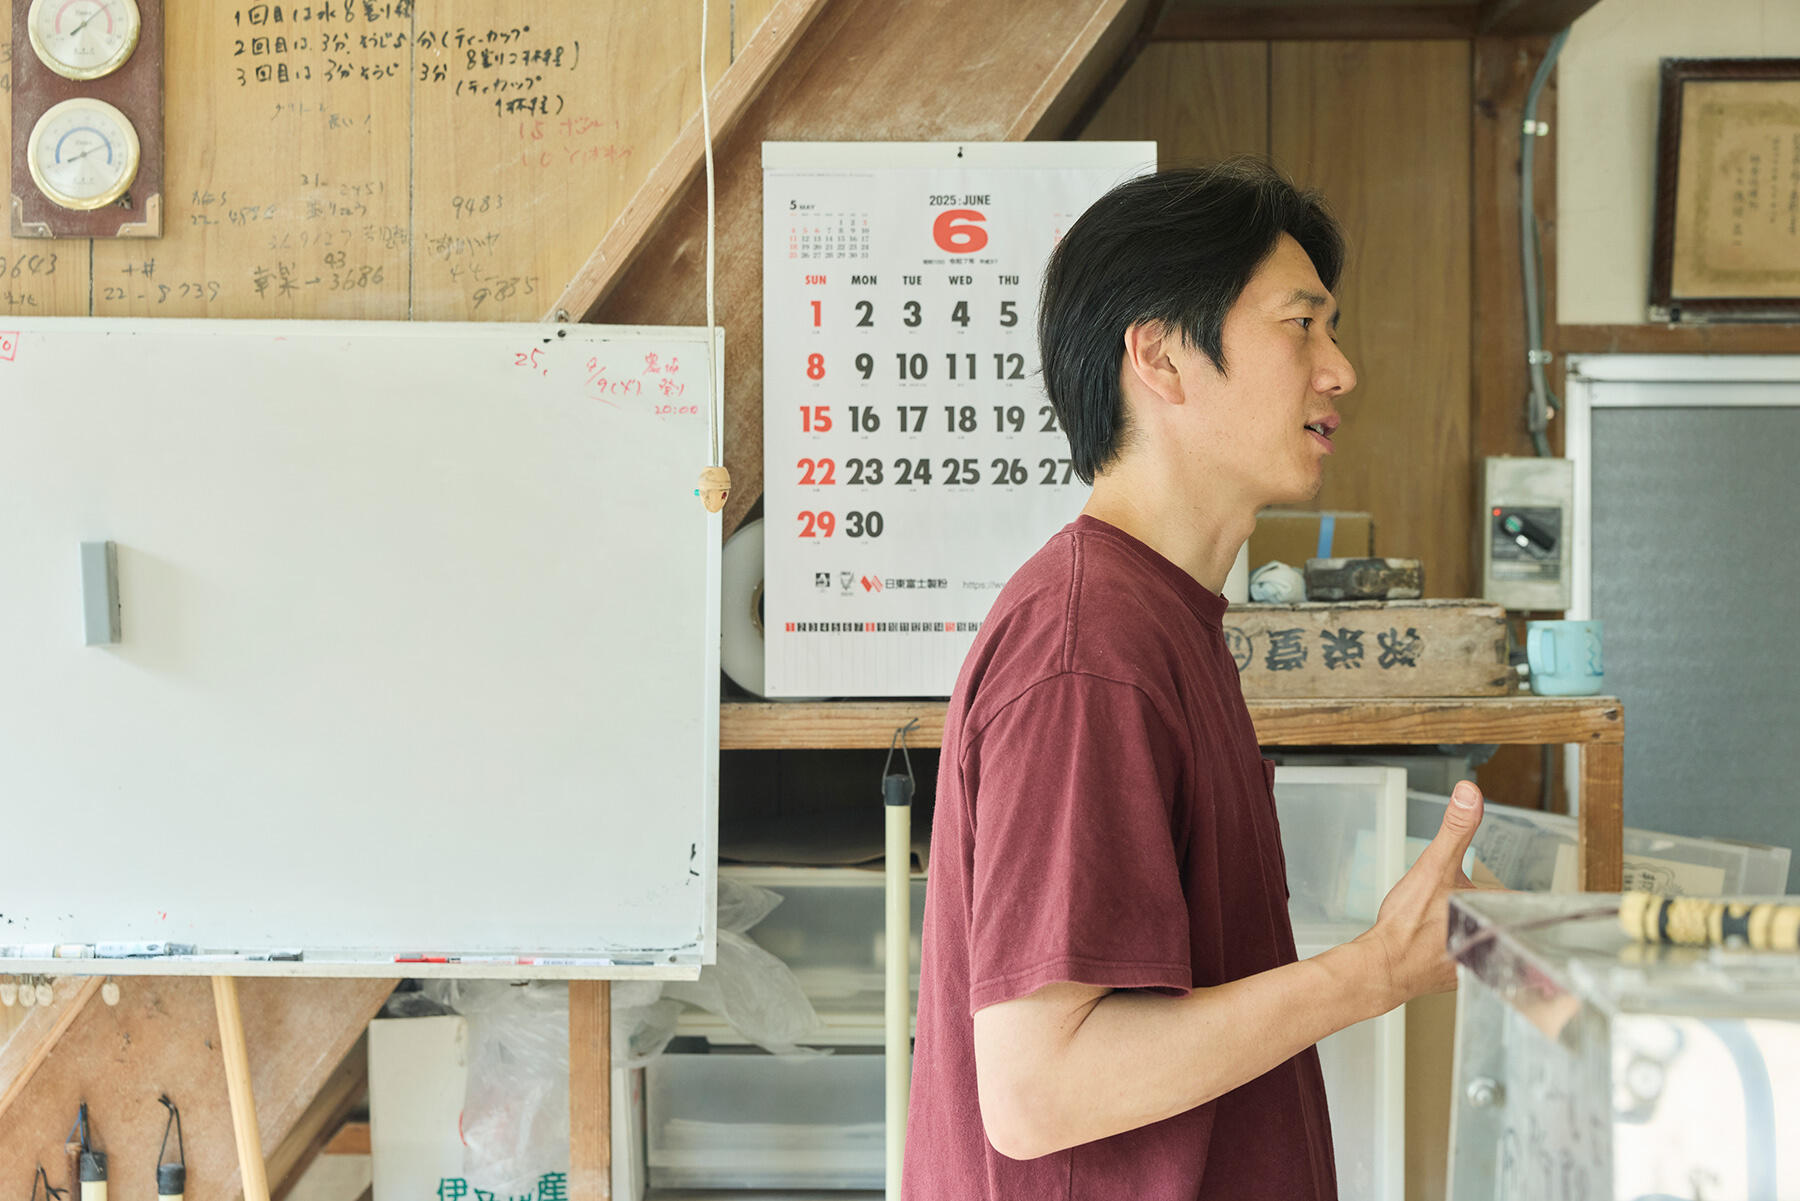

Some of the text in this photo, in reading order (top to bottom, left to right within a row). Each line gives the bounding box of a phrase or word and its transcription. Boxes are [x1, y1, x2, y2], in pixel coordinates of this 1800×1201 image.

[789, 199, 798, 211] 5
[932, 208, 989, 254] 6
[805, 274, 1020, 286] SUN MON TUE WED THU
[810, 300, 1019, 328] 1 2 3 4 5
[806, 352, 1025, 381] 8 9 10 11 12
[799, 405, 833, 433] 15
[848, 405, 881, 433] 16
[896, 405, 929, 433] 17
[944, 405, 978, 433] 18
[993, 405, 1026, 433] 19
[796, 457, 1073, 486] 22 23 24 25 26 27
[797, 510, 884, 538] 29 30
[884, 577, 949, 590] 日東富士製粉
